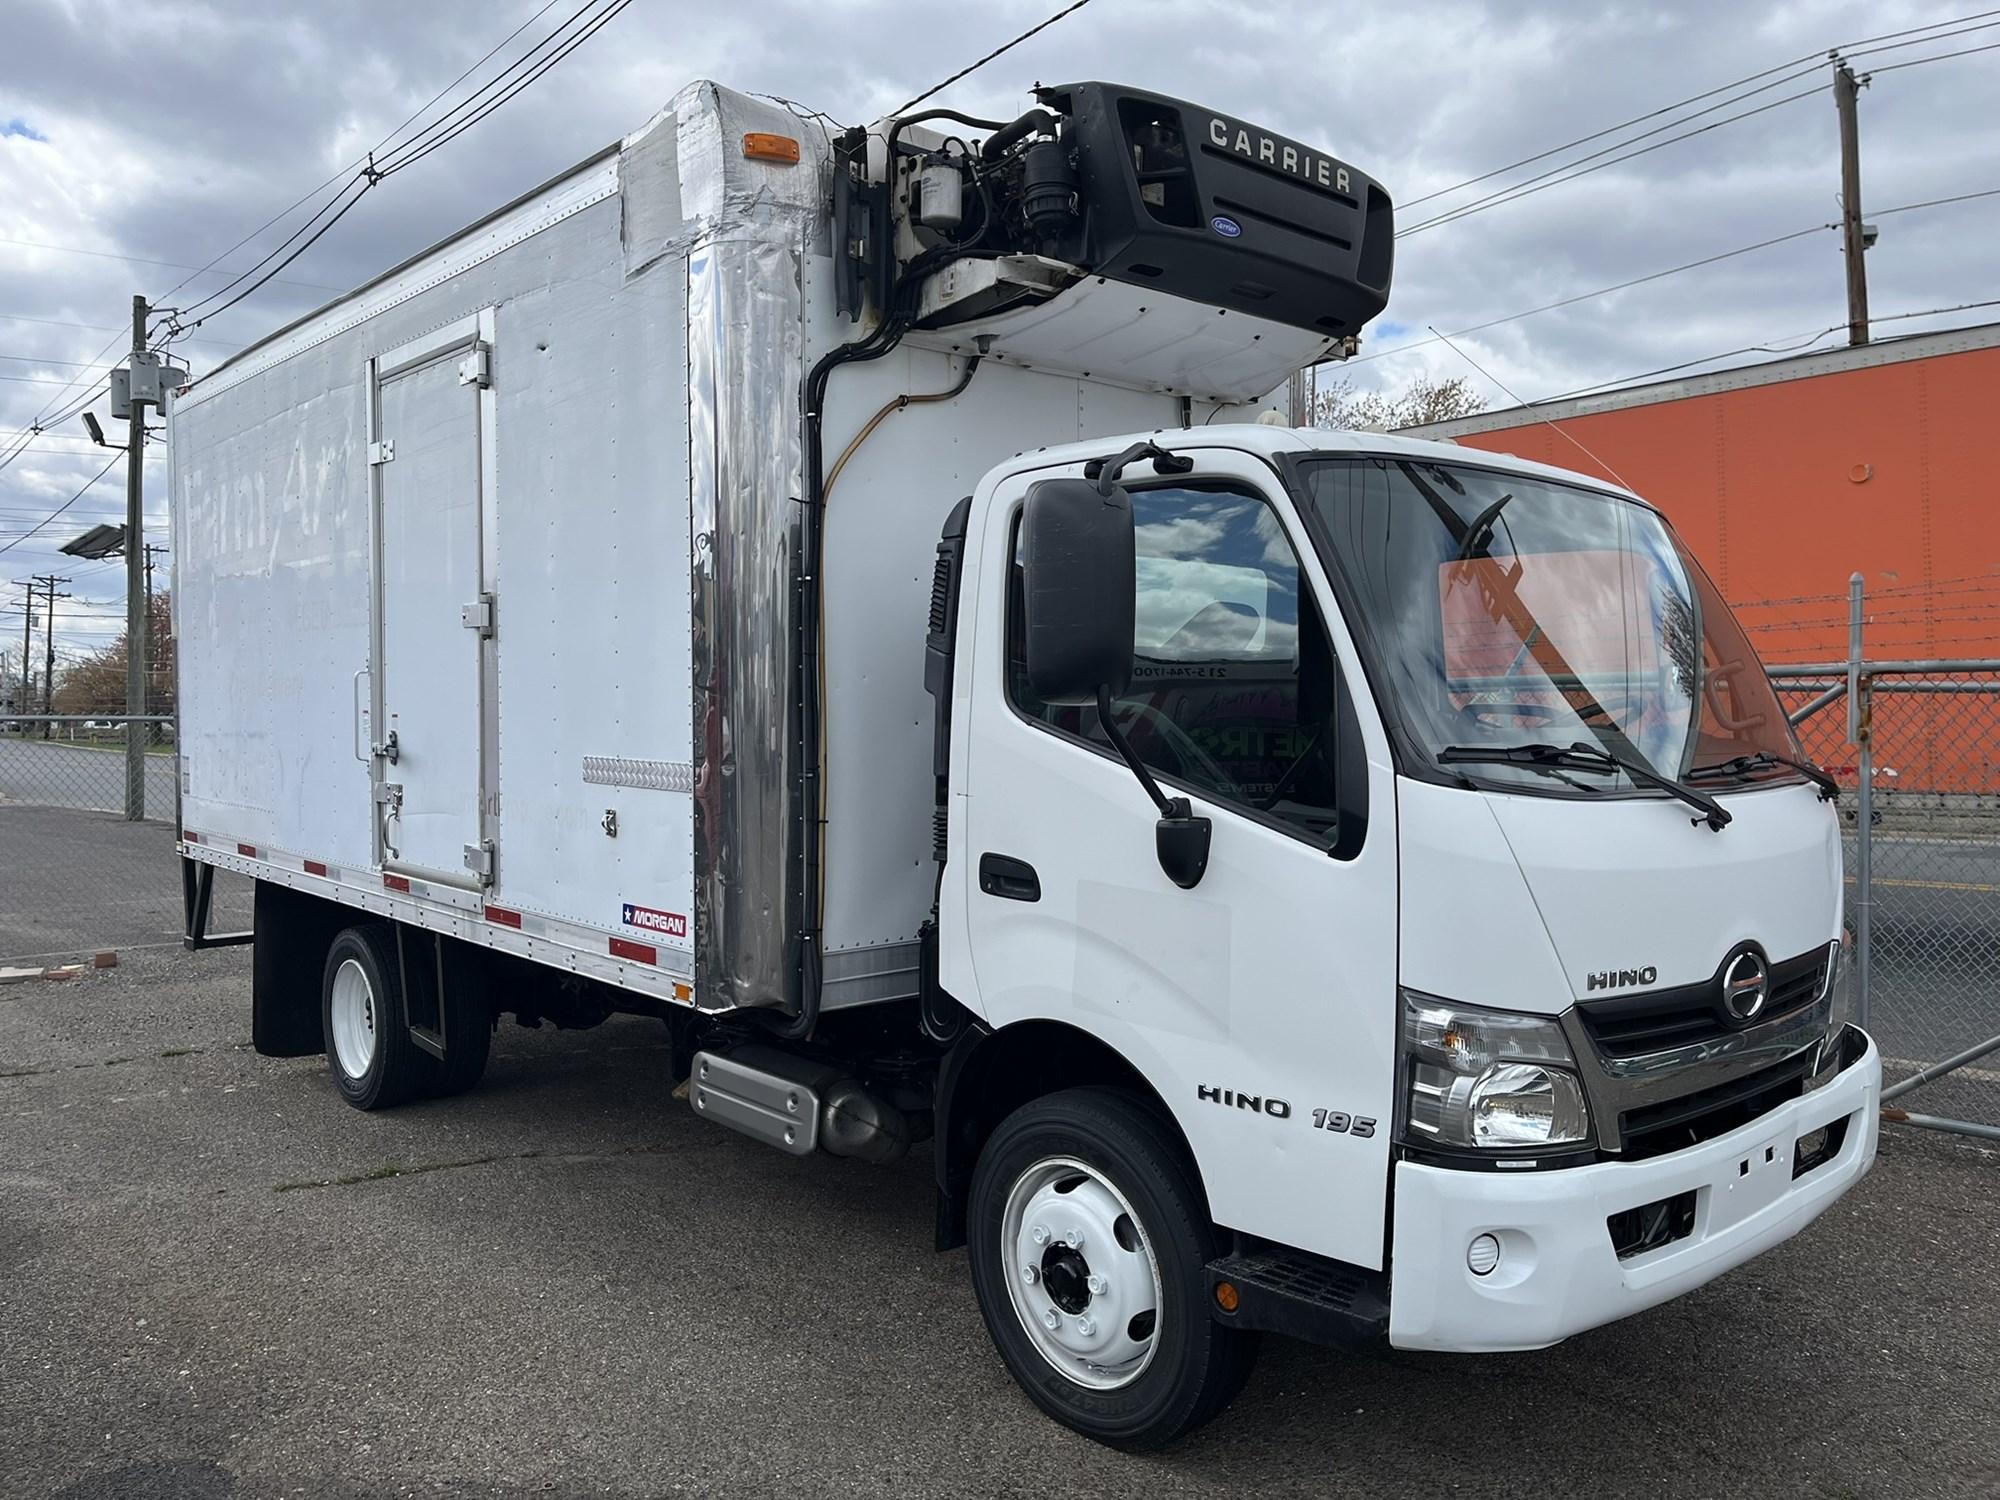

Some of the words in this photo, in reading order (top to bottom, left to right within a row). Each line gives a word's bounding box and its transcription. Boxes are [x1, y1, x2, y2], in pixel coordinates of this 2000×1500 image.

[1210, 119, 1350, 193] CARRIER
[633, 910, 685, 934] MORGAN
[1587, 966, 1657, 991] HINO
[1197, 1082, 1292, 1119] HINO
[1312, 1108, 1377, 1138] 195
